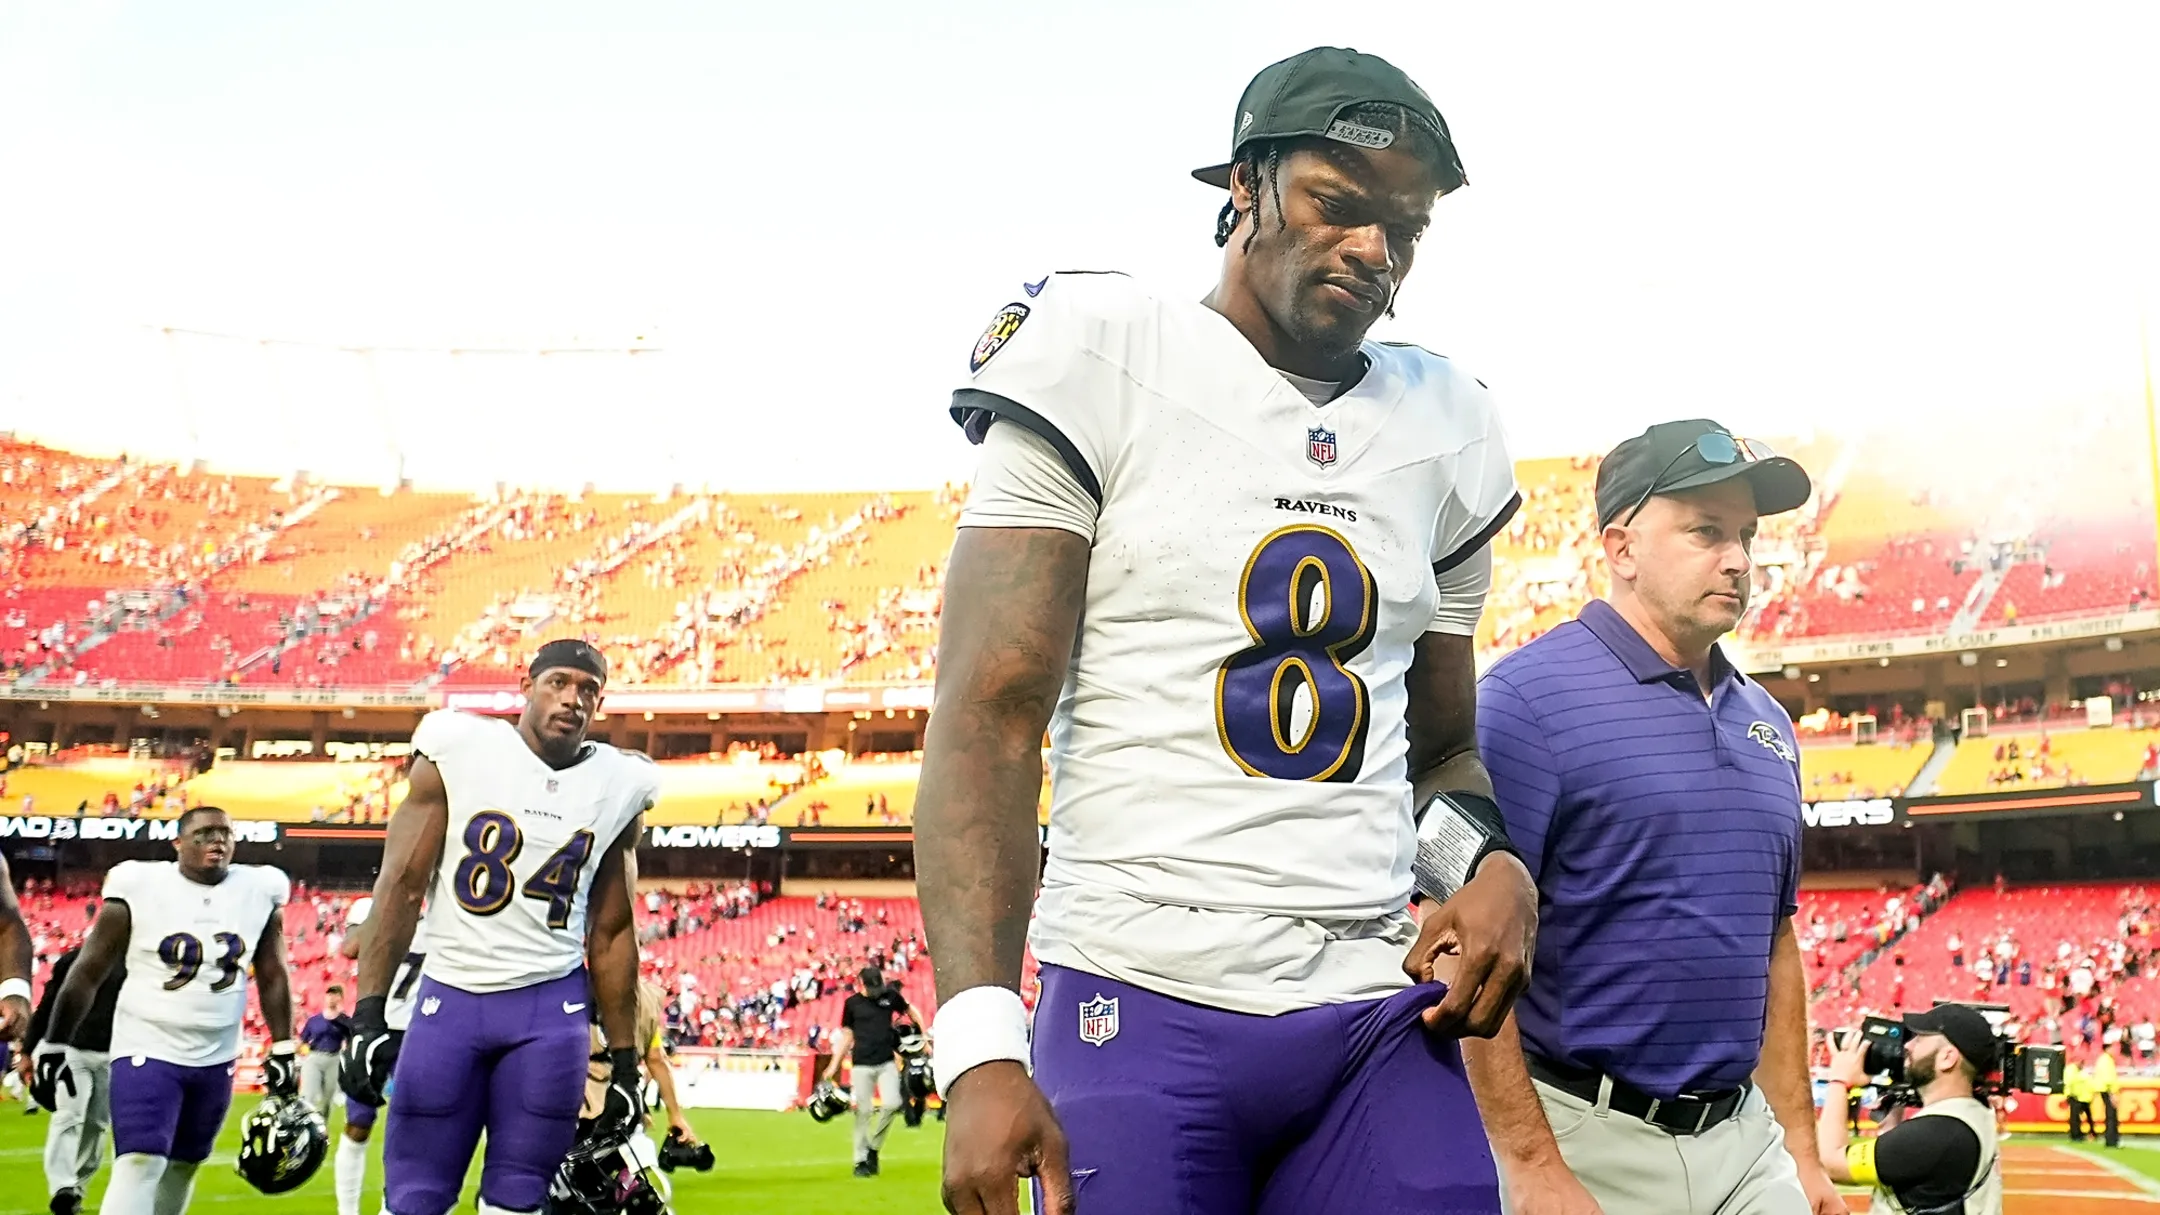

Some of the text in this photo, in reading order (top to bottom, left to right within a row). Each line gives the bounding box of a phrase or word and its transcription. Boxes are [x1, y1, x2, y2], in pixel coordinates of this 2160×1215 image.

[1312, 442, 1334, 461] NFL
[1273, 497, 1357, 522] RAVENS
[1214, 523, 1379, 783] 8
[1801, 798, 1894, 828] WERS
[80, 818, 147, 840] BOY
[652, 824, 781, 848] MOWERS
[453, 809, 595, 930] 84
[157, 931, 247, 994] 93
[1086, 1017, 1112, 1037] NFL
